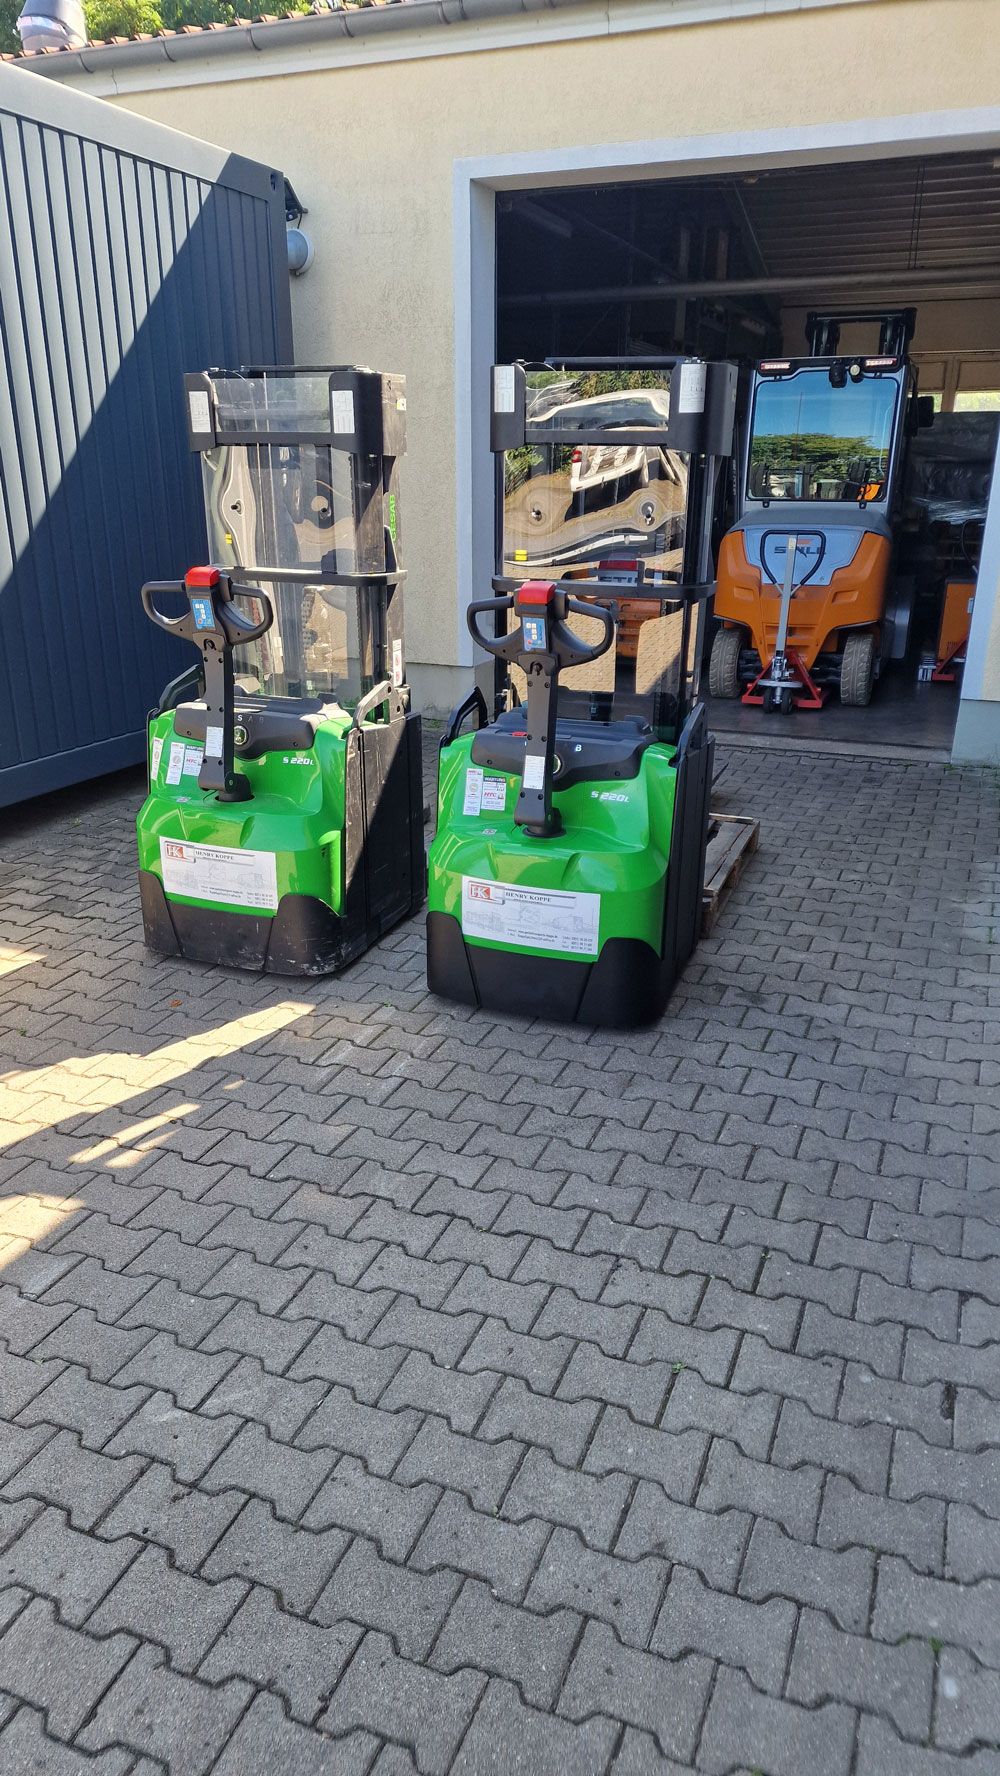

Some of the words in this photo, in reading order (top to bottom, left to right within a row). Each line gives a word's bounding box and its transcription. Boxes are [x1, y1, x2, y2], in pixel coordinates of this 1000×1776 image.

[282, 756, 289, 764] S
[195, 850, 214, 858] HENRY
[215, 853, 234, 861] KOPPE
[505, 891, 528, 900] HENRY
[529, 895, 551, 903] KOPPE
